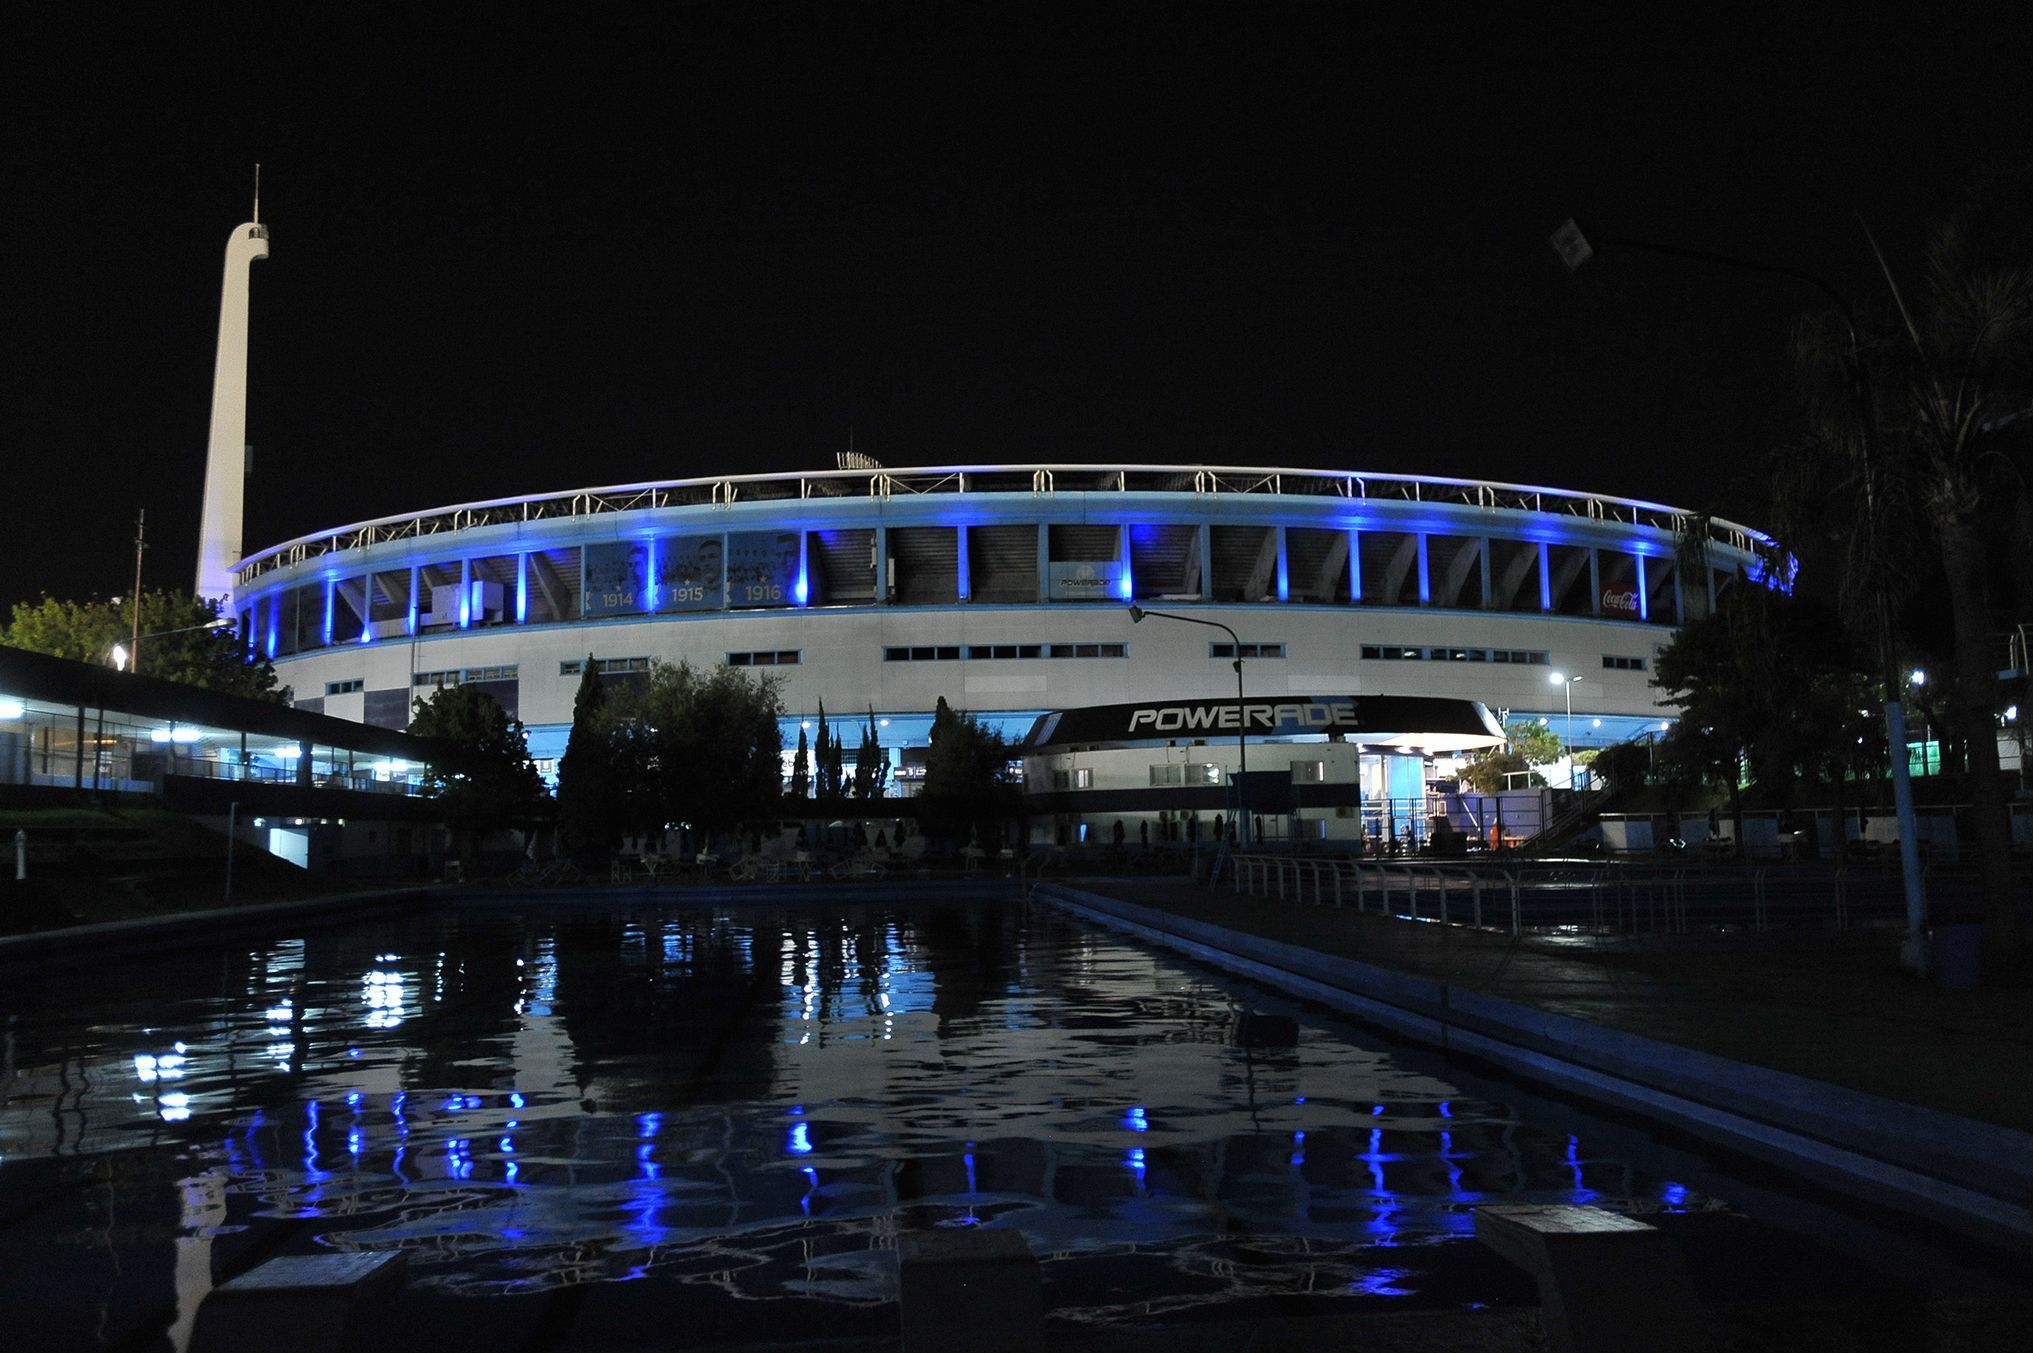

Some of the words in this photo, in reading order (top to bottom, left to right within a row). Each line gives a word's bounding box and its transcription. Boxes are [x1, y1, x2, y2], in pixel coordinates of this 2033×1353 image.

[602, 592, 634, 608] 1914
[672, 586, 704, 602] 1915
[746, 584, 782, 601] 1916
[1128, 703, 1360, 733] POWERADE
